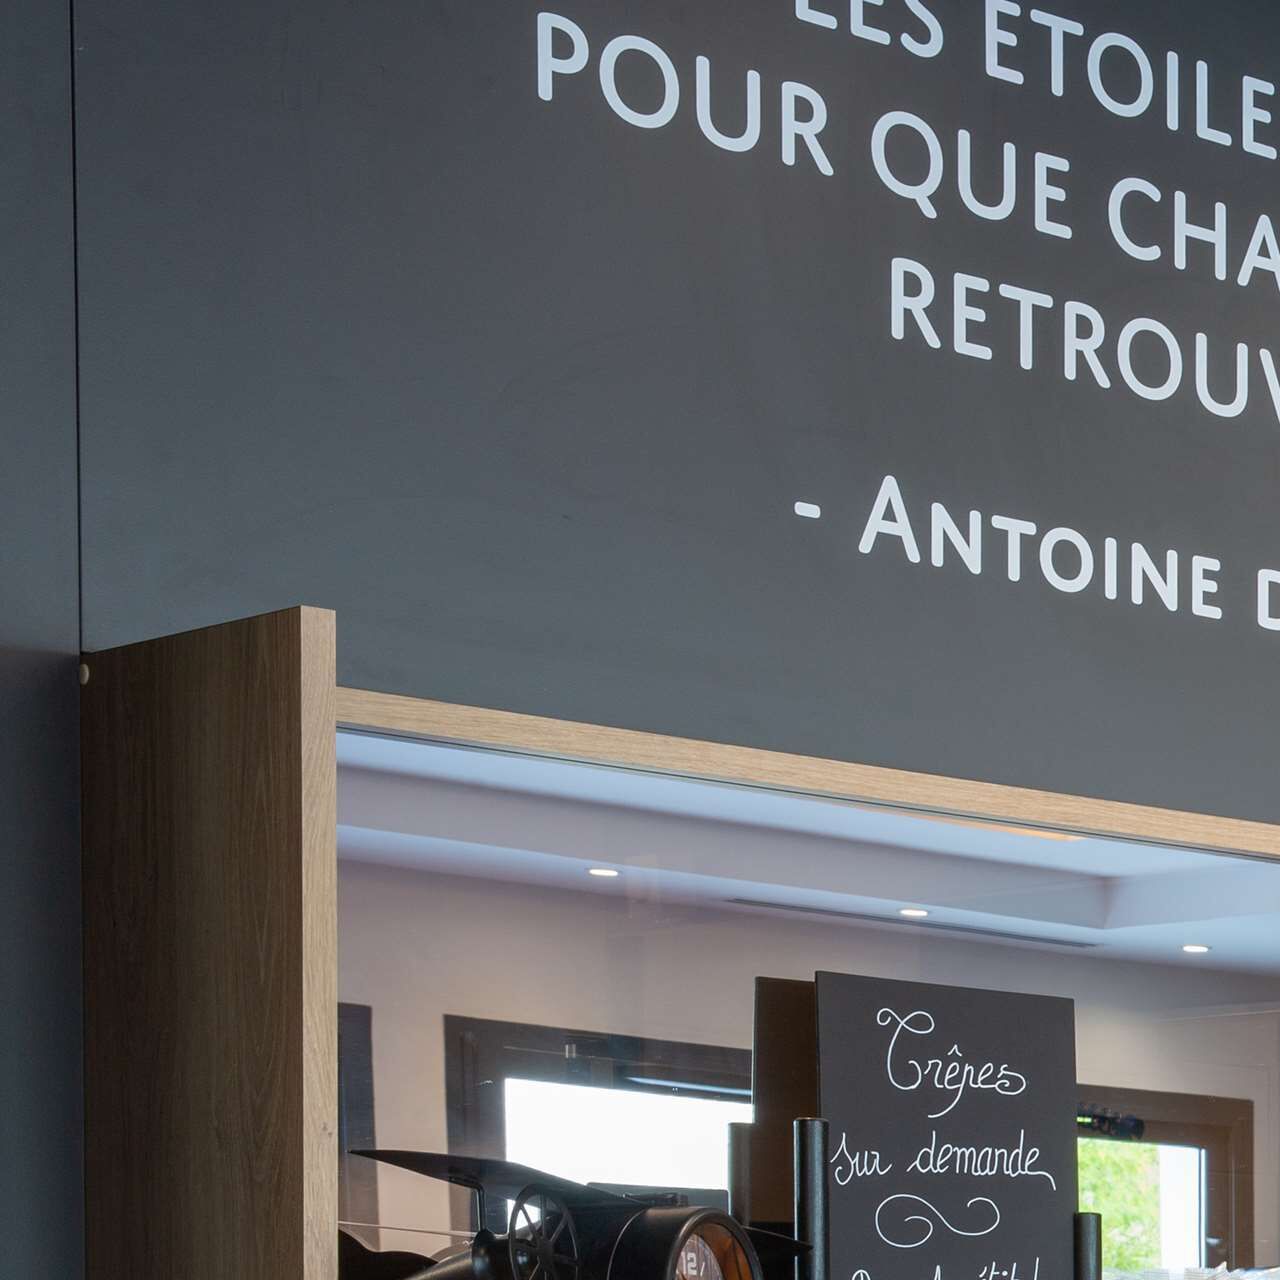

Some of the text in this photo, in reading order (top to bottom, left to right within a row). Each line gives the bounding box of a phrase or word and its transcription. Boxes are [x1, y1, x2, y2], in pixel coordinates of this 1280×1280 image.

[537, 11, 834, 177] POUR
[870, 110, 1073, 240] QUE
[858, 474, 1223, 620] ANTOINE
[876, 1007, 1027, 1119] Crêpes
[906, 1128, 1057, 1191] demande
